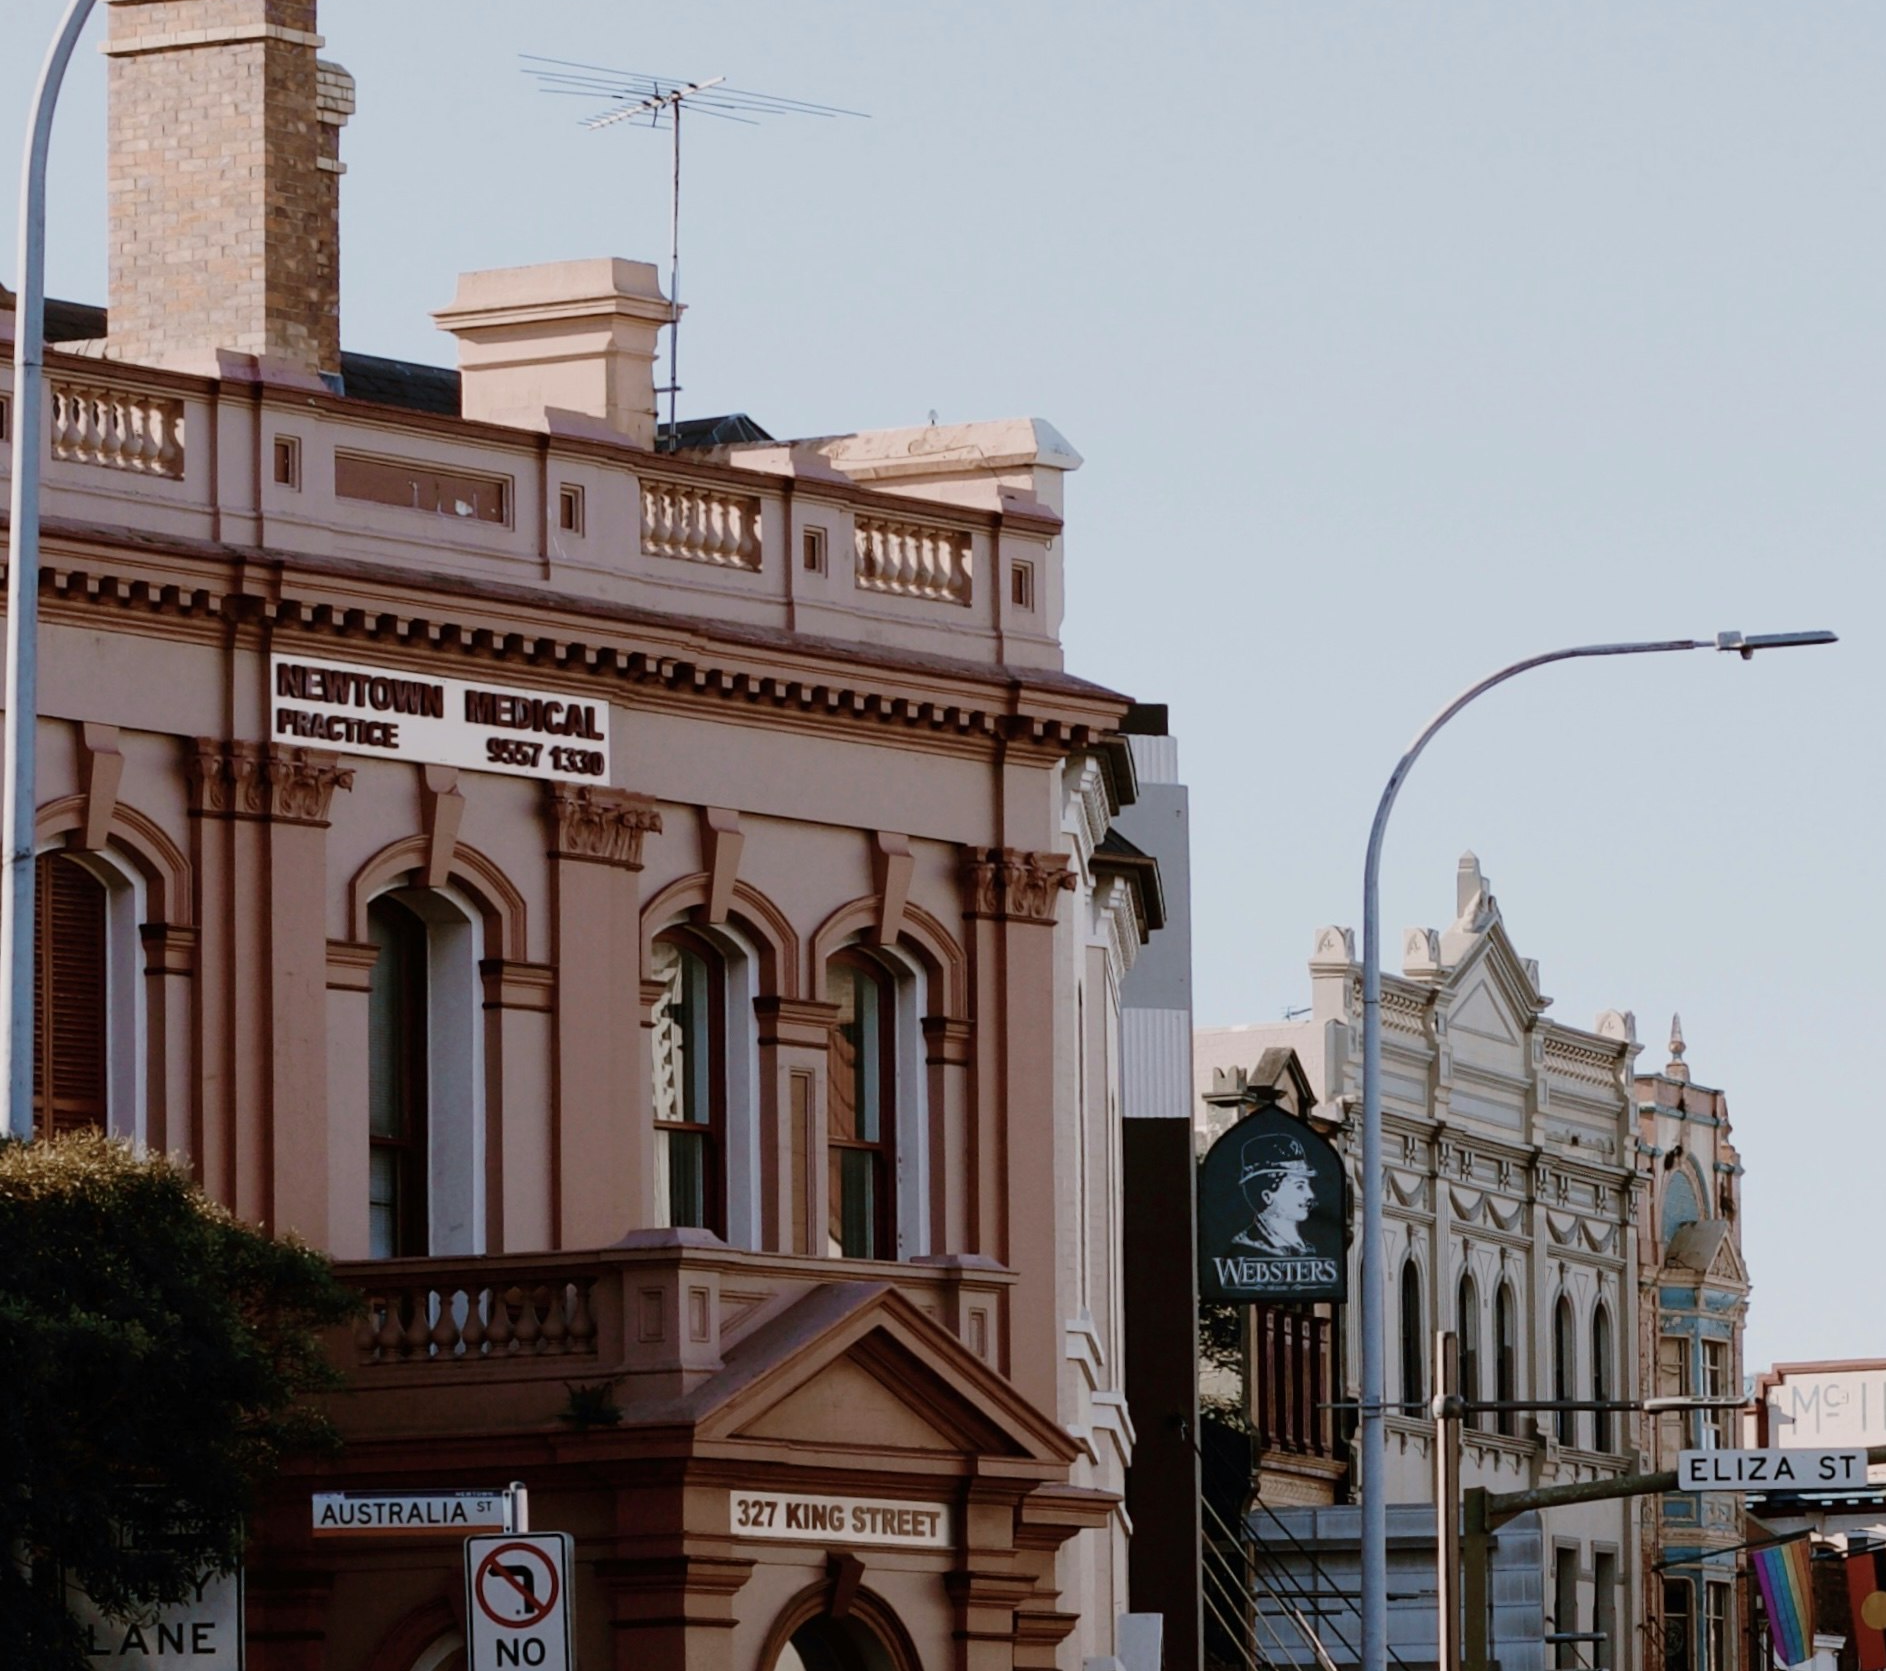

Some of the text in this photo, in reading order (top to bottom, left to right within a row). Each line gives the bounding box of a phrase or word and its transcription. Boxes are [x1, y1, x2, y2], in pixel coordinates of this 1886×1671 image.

[277, 663, 605, 741] NEWTOWN MEDICAL
[277, 709, 606, 776] PRACTICE 9557 1330
[1691, 1455, 1856, 1482] ELIZA ST
[320, 1501, 493, 1525] AUSTRALIA ST
[737, 1499, 941, 1538] 327 KING STREET
[87, 1623, 216, 1656] LANE
[496, 1638, 546, 1667] NO
